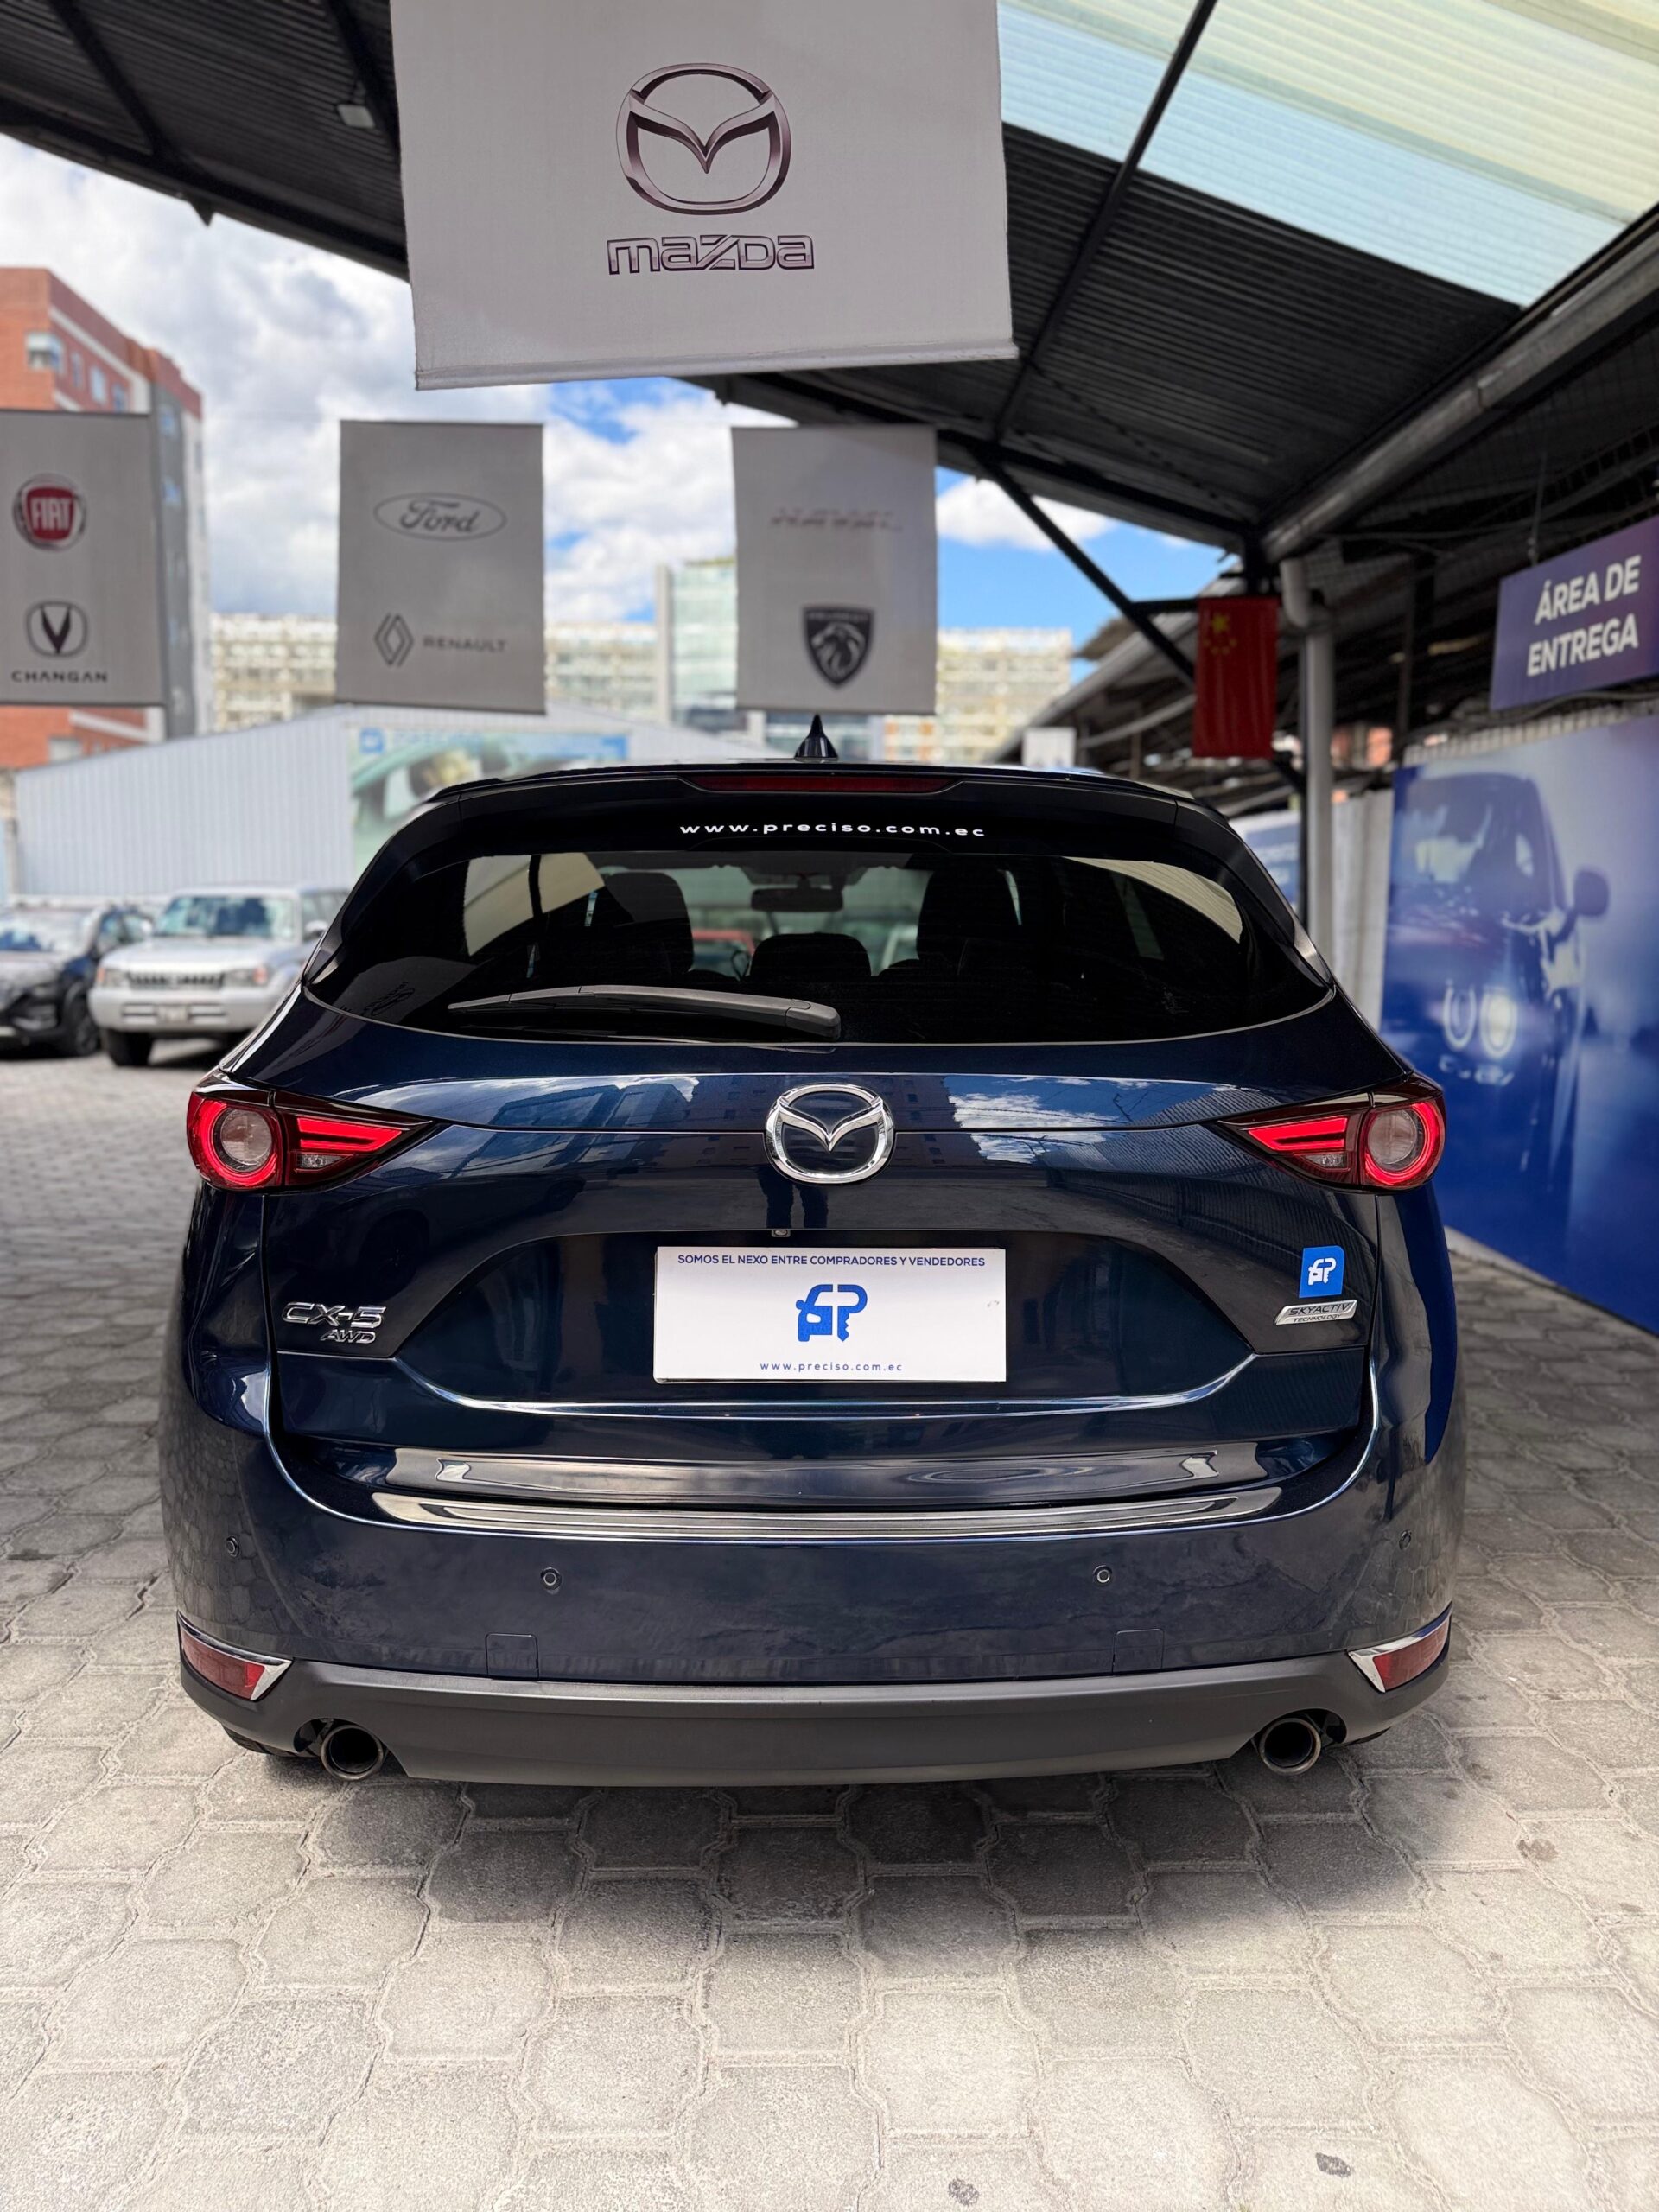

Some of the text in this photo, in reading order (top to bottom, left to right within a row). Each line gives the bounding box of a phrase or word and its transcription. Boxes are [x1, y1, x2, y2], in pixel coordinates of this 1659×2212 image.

[31, 495, 73, 531] FIAT
[399, 499, 480, 533] Ford
[1535, 556, 1642, 625] ÁREA DE
[423, 636, 506, 653] RENAULT
[1526, 613, 1638, 677] ENTREGA
[11, 670, 108, 683] CHANGAN
[679, 822, 985, 836] www.preciso.com.ec
[677, 1255, 986, 1267] SOMOS EL NEXO ENTRE COMPRADORES Y VENDEDORES
[282, 1301, 387, 1328] CX-5
[1288, 1302, 1351, 1316] SKYACTIV
[1293, 1313, 1343, 1323] TECHNOLOGY
[320, 1329, 377, 1344] AWD
[760, 1362, 903, 1373] www.preciso.com.ec
